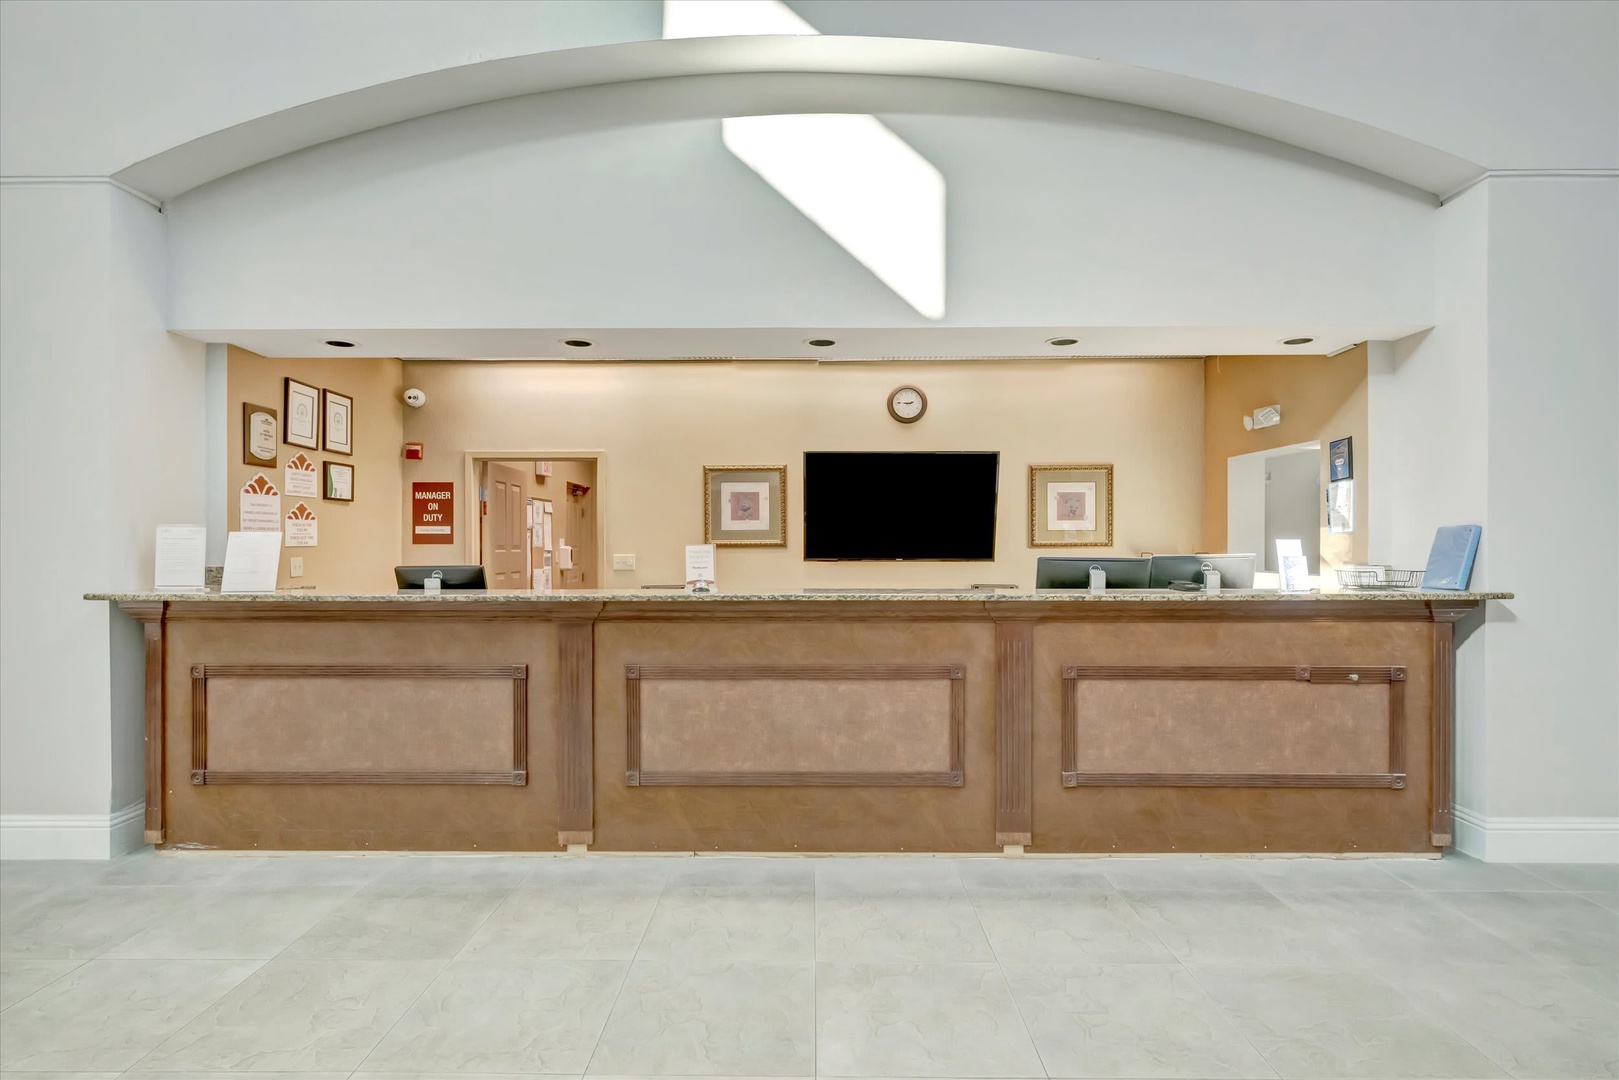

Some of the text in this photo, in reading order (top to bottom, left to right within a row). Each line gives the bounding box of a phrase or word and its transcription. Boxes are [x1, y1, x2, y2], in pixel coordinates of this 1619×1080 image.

[415, 491, 451, 500] MANAGER
[427, 502, 439, 511] ON
[423, 513, 443, 522] DUTY
